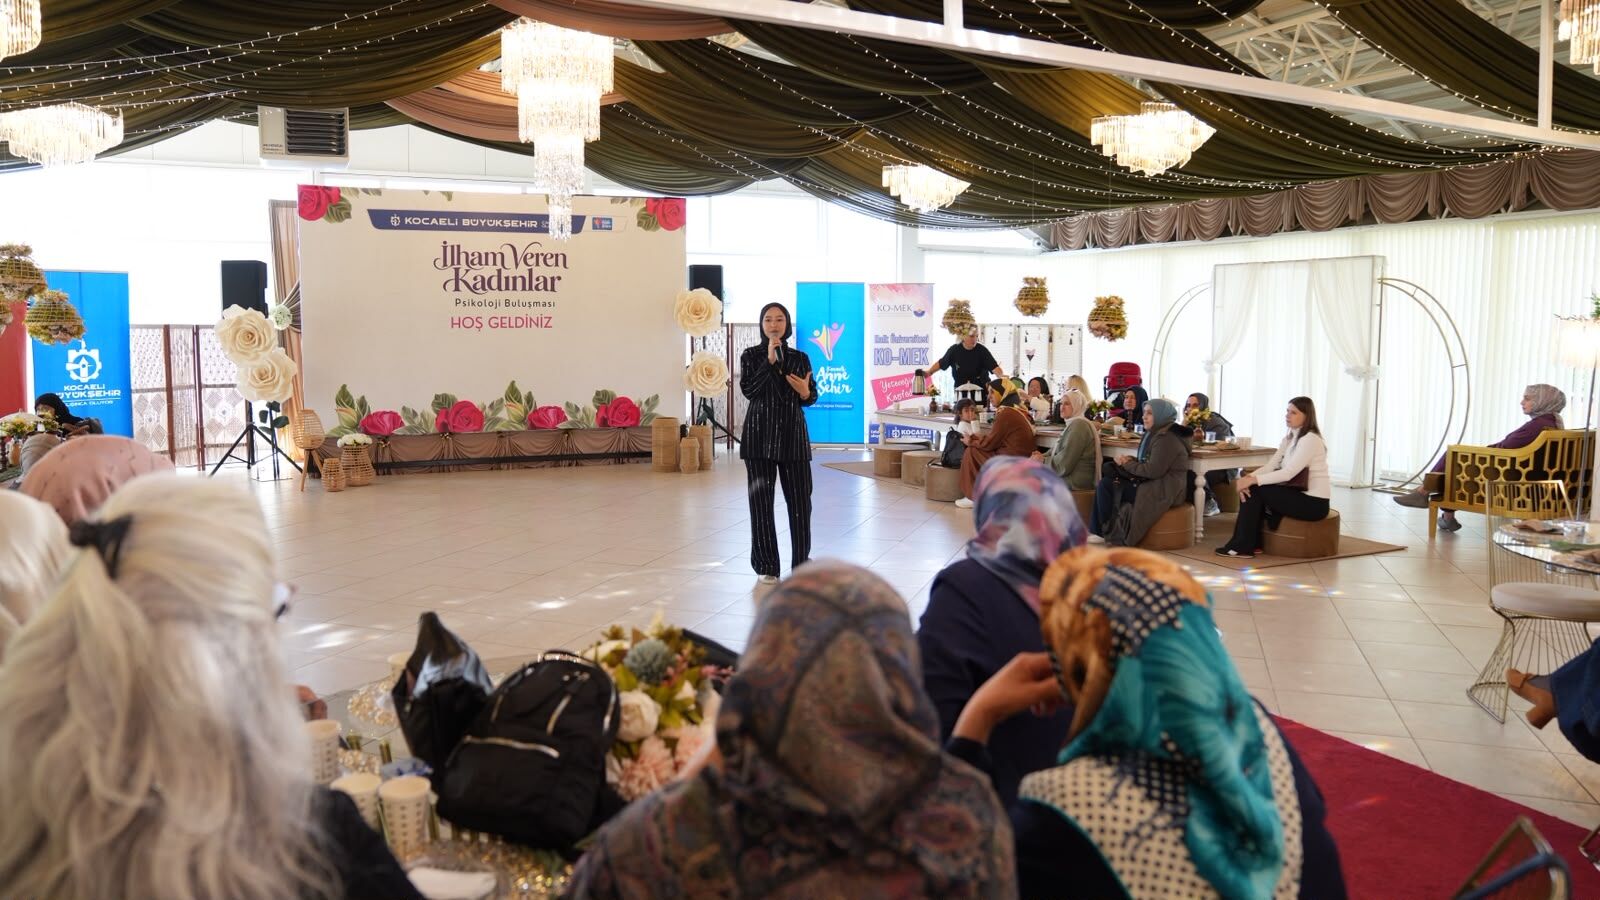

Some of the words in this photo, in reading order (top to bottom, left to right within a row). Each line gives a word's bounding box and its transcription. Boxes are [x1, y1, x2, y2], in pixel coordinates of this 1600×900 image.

[433, 240, 505, 271] İlham
[500, 241, 569, 271] Veren
[443, 267, 562, 295] Kadınlar
[455, 298, 501, 309] Psikoloji
[504, 299, 556, 308] Buluşması
[877, 304, 912, 312] KO-MEK
[450, 316, 484, 332] HOŞ
[488, 313, 553, 329] GELDİNİZ
[874, 347, 929, 366] KO-MEK
[815, 366, 850, 382] Anne
[817, 381, 852, 396] Şehir
